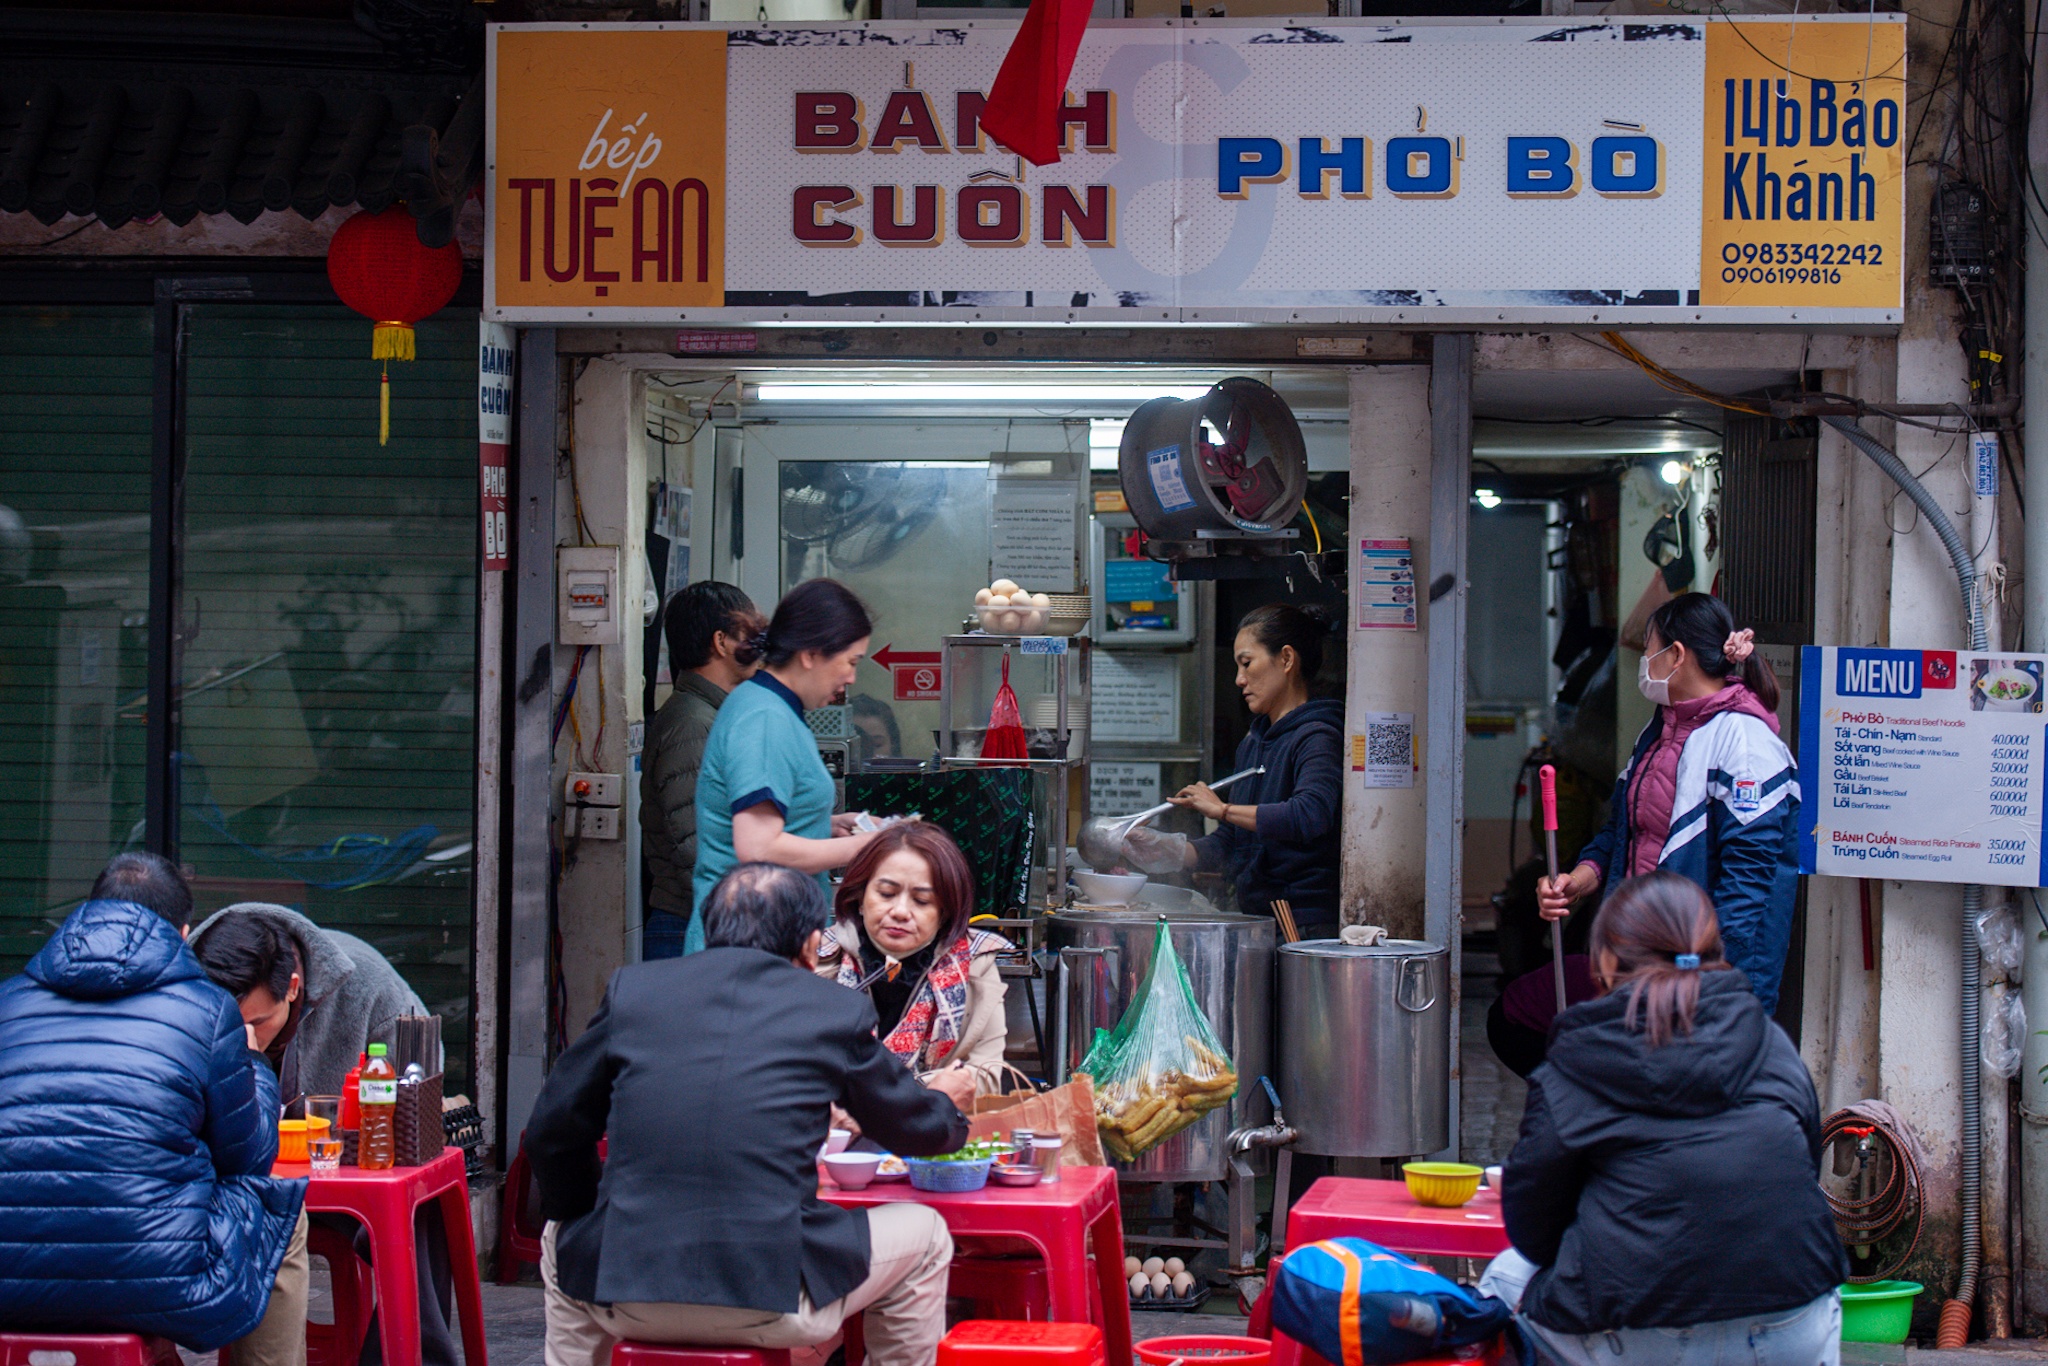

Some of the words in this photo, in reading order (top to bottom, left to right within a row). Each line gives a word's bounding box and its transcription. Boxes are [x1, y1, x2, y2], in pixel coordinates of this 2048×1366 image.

[1725, 78, 1801, 147] 14b
[1809, 78, 1899, 147] Bảo
[578, 108, 662, 198] bếp
[1216, 104, 1465, 200] PHỞ
[1505, 118, 1666, 200] BÒ
[1723, 152, 1876, 222] Khánh
[508, 177, 621, 297] TUỆ
[631, 177, 709, 283] AN
[1721, 243, 1882, 265] 0983342242
[1721, 267, 1841, 284] 0906199816
[1845, 658, 1915, 695] MENU
[1886, 717, 1921, 726] Traditional
[1922, 719, 1939, 727] Beef
[1940, 720, 1966, 728] Noodle
[1834, 727, 1851, 738] Tái
[1858, 728, 1883, 740] Chín
[1890, 730, 1917, 743] Nạm
[1834, 740, 1853, 753] Sốt
[1855, 745, 1881, 756] vang
[1882, 747, 1895, 755] Beef
[1834, 754, 1853, 767] Sốt
[1833, 767, 1856, 780] Gầu
[1833, 782, 1850, 794] Tái
[1899, 837, 1931, 846] Steamed
[1932, 839, 1948, 847] Rice
[1949, 840, 1981, 848] Pancake
[1832, 845, 1866, 860] Trứng
[1869, 845, 1899, 859] Cuốn
[1928, 854, 1940, 862] Egg
